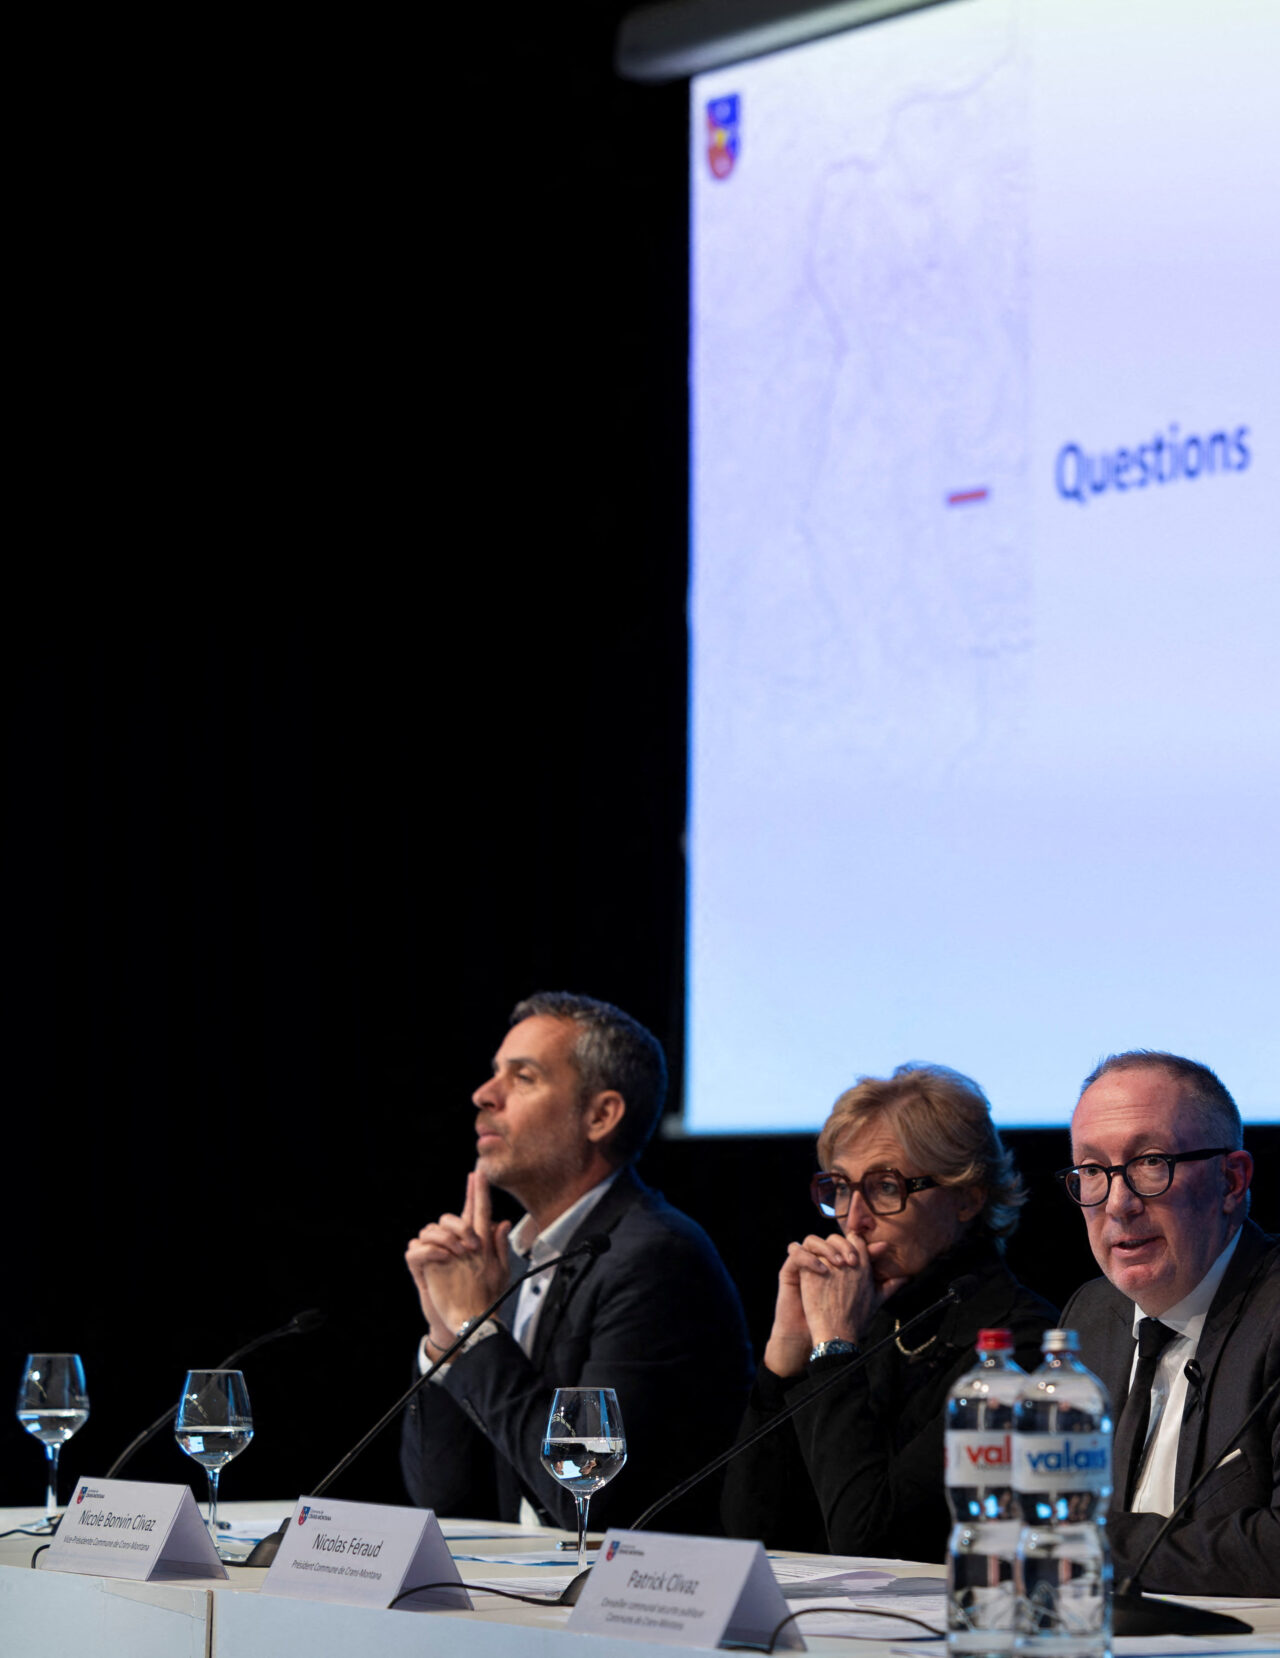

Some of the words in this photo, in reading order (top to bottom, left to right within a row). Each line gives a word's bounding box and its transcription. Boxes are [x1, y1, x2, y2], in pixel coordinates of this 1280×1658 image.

[1055, 421, 1251, 504] Questions
[966, 1434, 1012, 1466] val
[78, 1510, 104, 1527] Nicole
[103, 1512, 132, 1530] Bonvin
[132, 1514, 156, 1532] Clivaz
[312, 1533, 348, 1554] Nicolas
[347, 1537, 384, 1558] Féraud
[313, 1562, 338, 1574] Commune
[337, 1565, 346, 1575] de
[627, 1569, 666, 1591] Patrick
[666, 1573, 700, 1596] Clivaz
